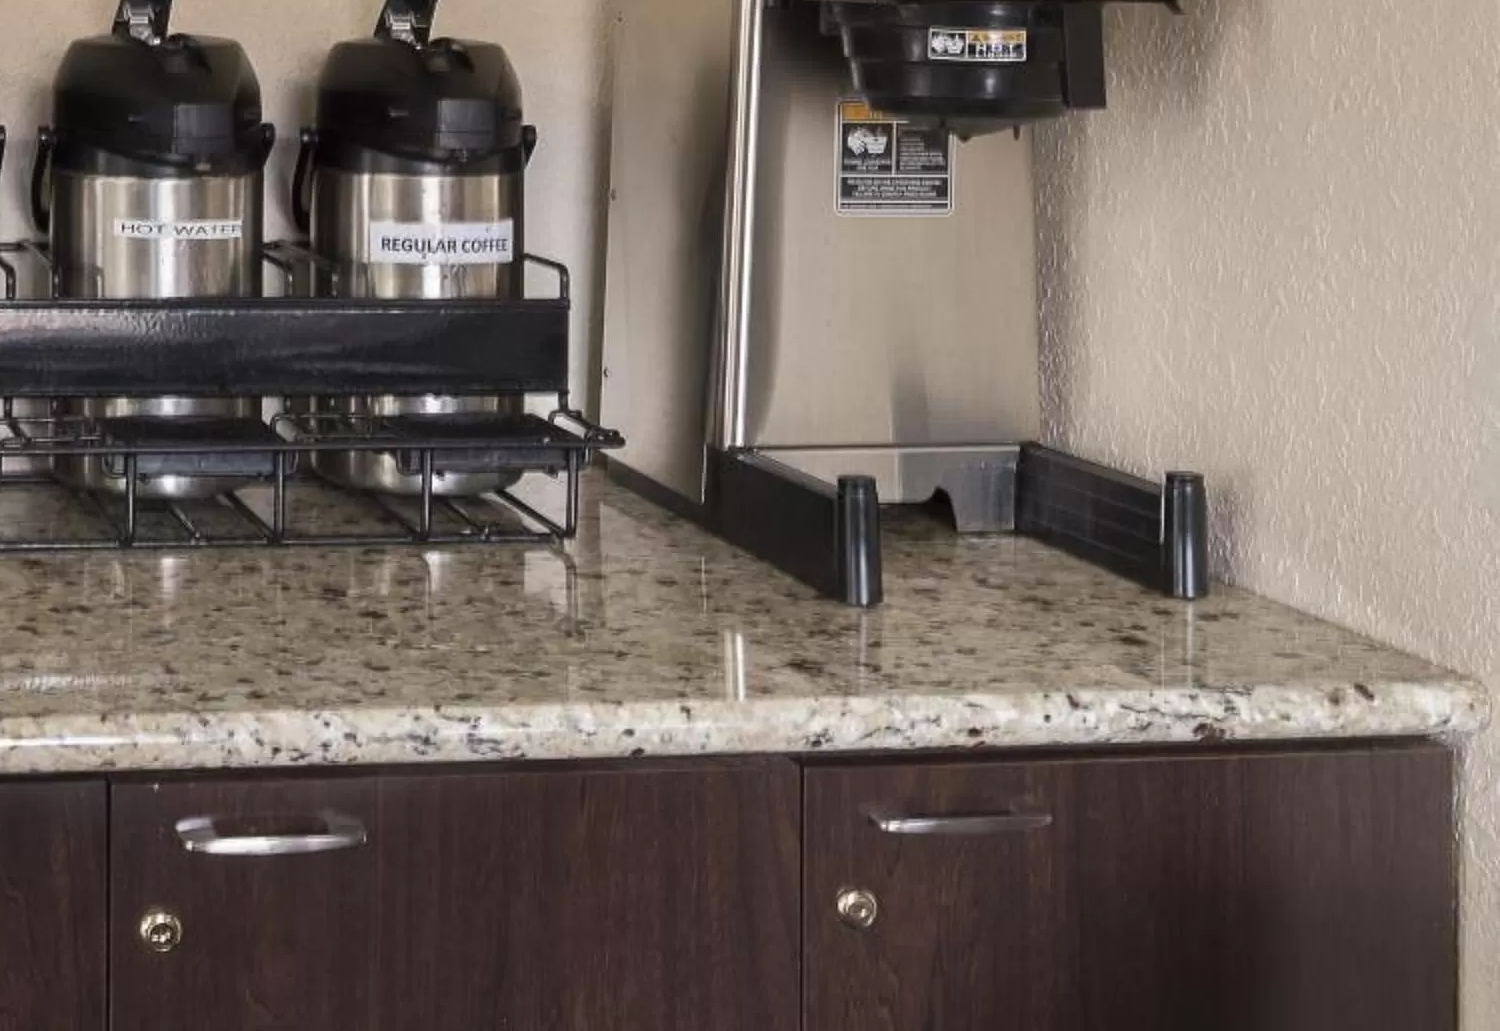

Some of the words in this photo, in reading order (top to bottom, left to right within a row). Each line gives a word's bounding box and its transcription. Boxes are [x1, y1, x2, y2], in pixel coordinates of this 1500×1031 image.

[121, 222, 163, 235] HOT
[381, 237, 457, 254] REGULAR
[460, 237, 508, 253] COFFEE
